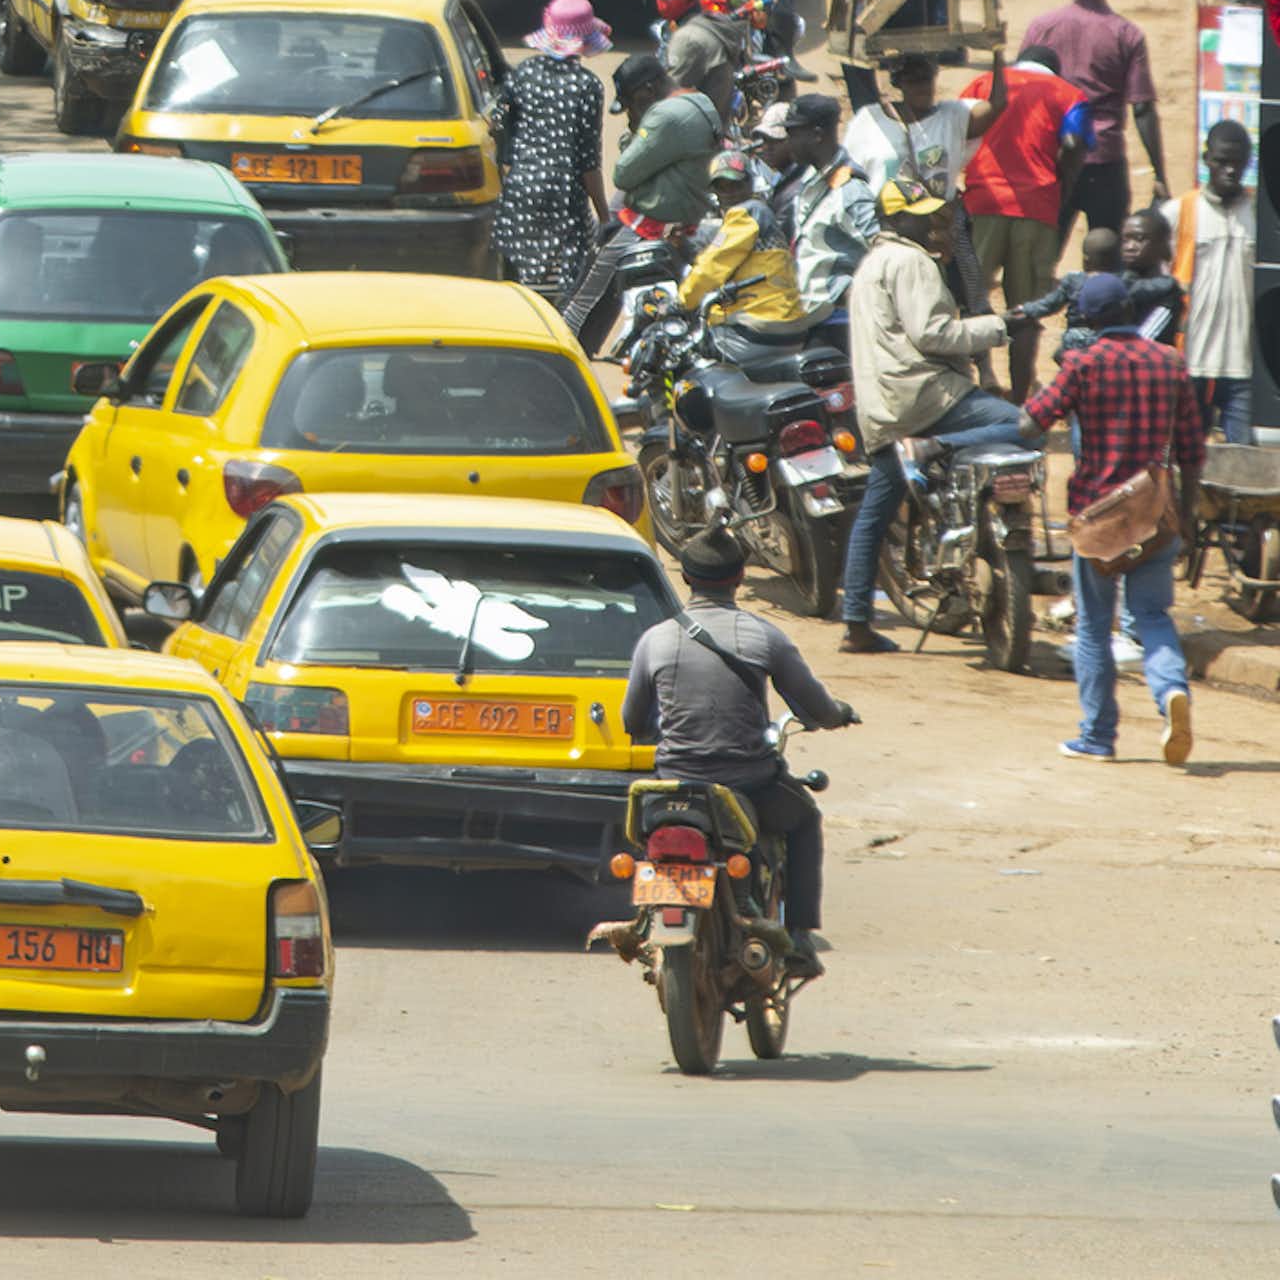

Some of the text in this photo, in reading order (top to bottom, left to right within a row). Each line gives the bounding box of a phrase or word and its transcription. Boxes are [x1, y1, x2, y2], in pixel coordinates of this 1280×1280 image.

[437, 703, 466, 729] CE
[478, 705, 520, 731] 692
[7, 930, 56, 962] 156
